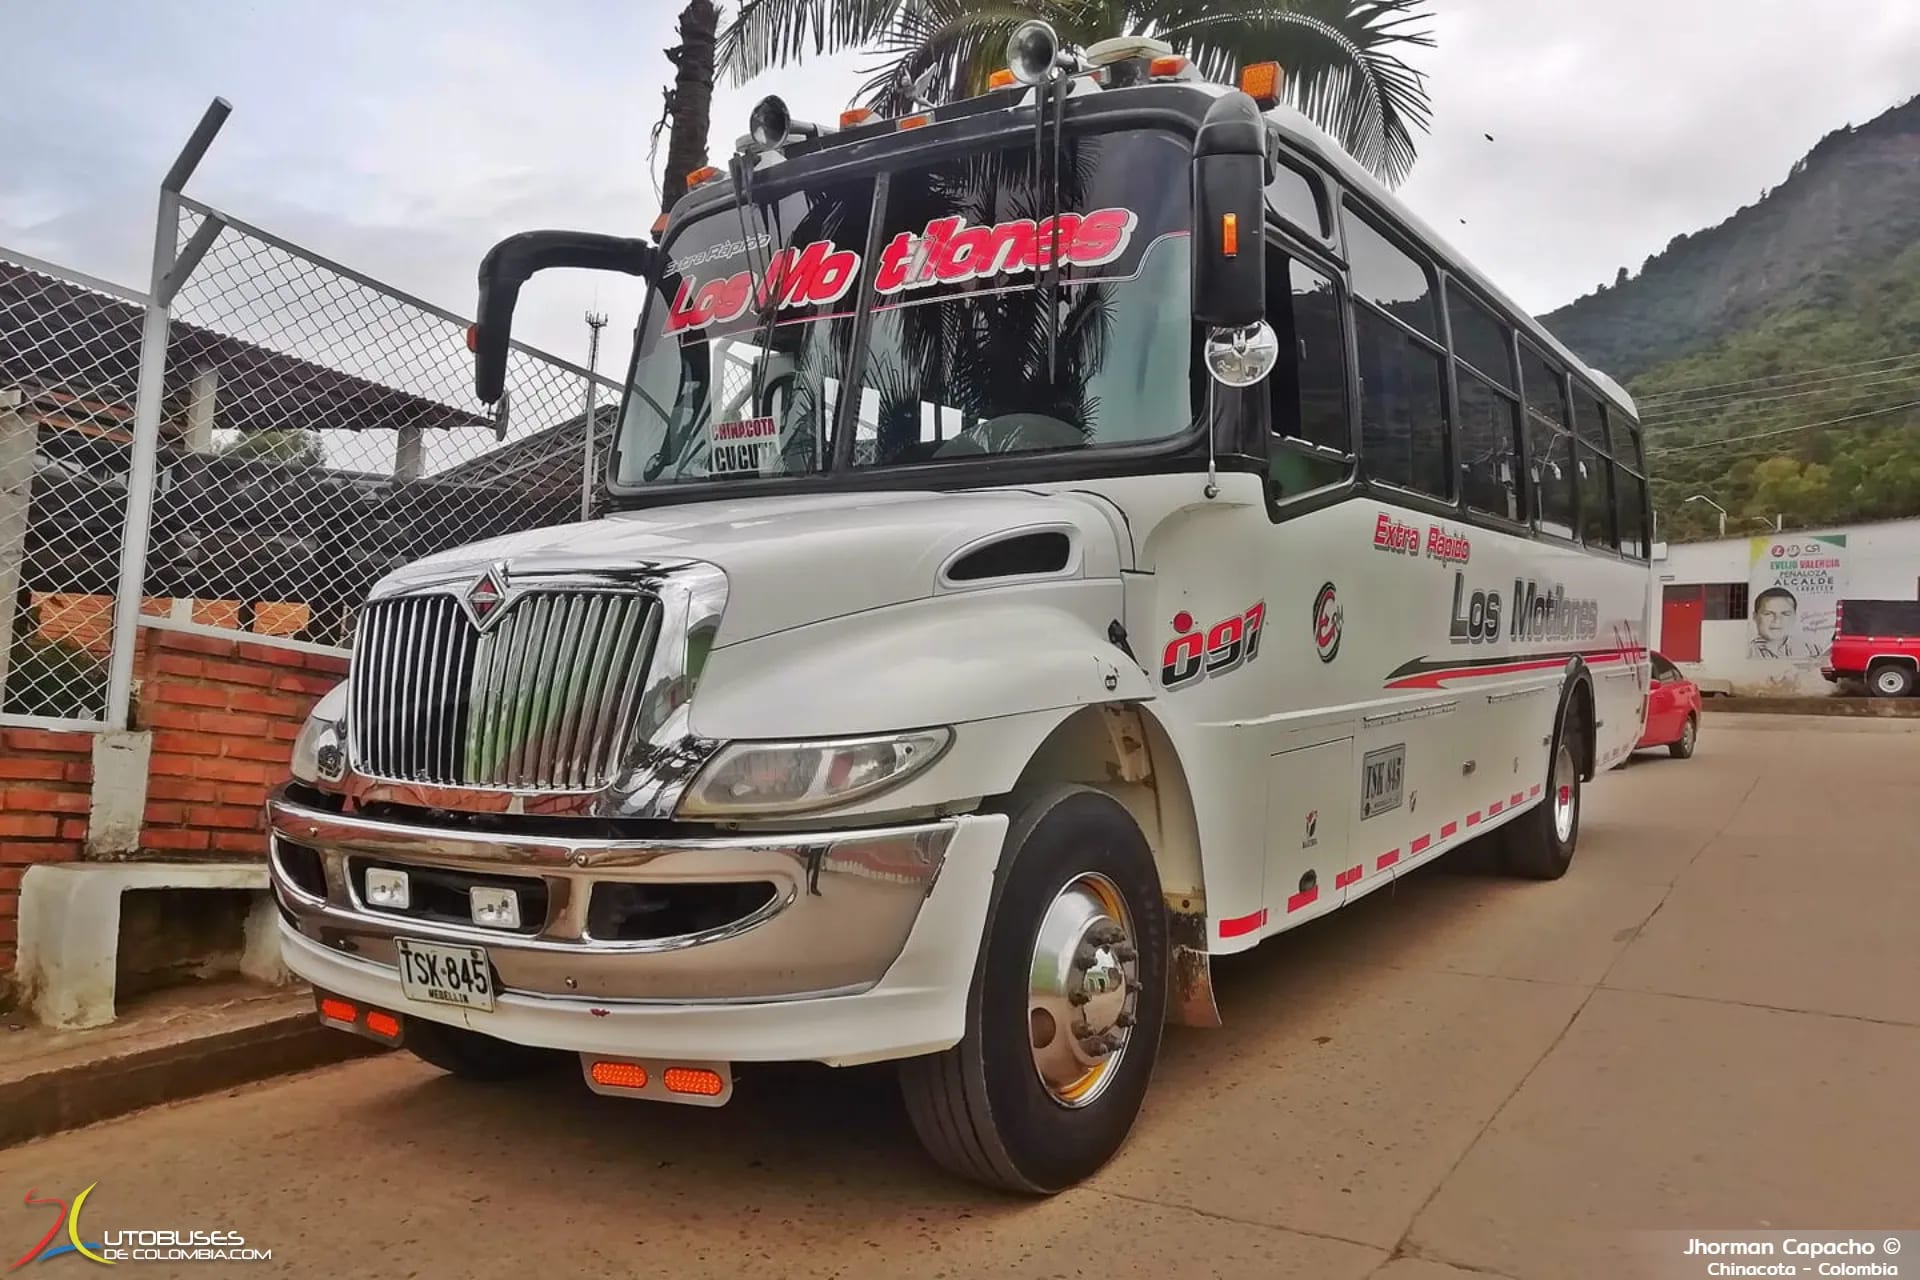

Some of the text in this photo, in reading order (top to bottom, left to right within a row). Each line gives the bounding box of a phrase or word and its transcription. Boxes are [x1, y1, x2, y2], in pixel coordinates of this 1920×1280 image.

[661, 271, 758, 338] Los
[1374, 511, 1420, 557] Extra
[1449, 568, 1598, 645] Los Motilones
[1774, 576, 1834, 586] ALCALDE
[1160, 599, 1266, 693] 097
[428, 988, 470, 1004] MEDELLIN
